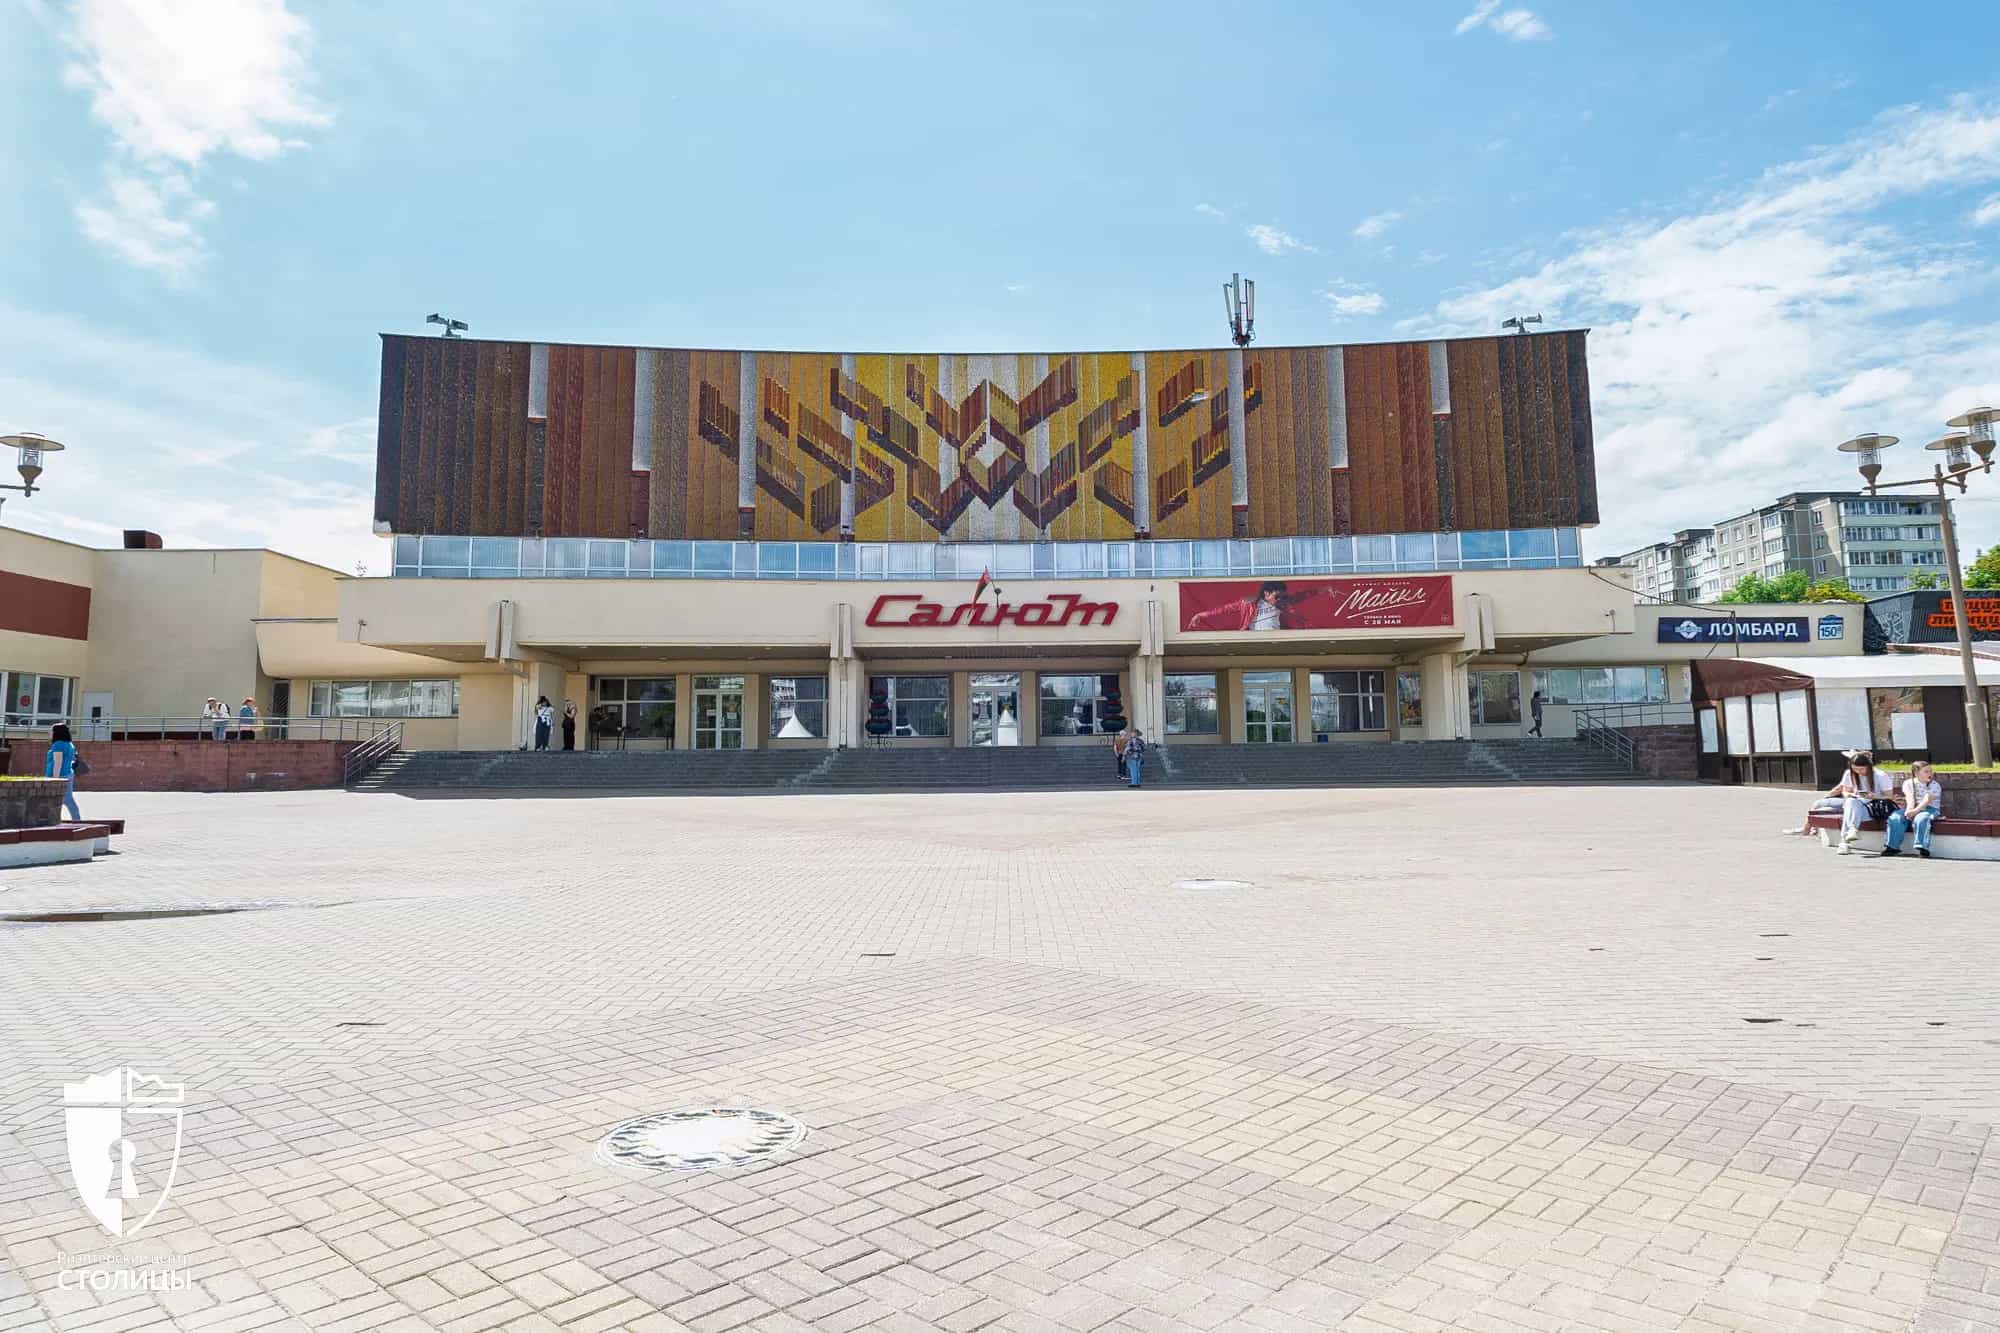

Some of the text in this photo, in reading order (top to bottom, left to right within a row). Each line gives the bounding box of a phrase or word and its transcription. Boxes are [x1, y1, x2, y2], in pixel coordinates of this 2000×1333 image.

[865, 594, 1119, 627] Салют
[1334, 587, 1427, 616] Майкл
[1708, 622, 1799, 637] ЛОМБАРД
